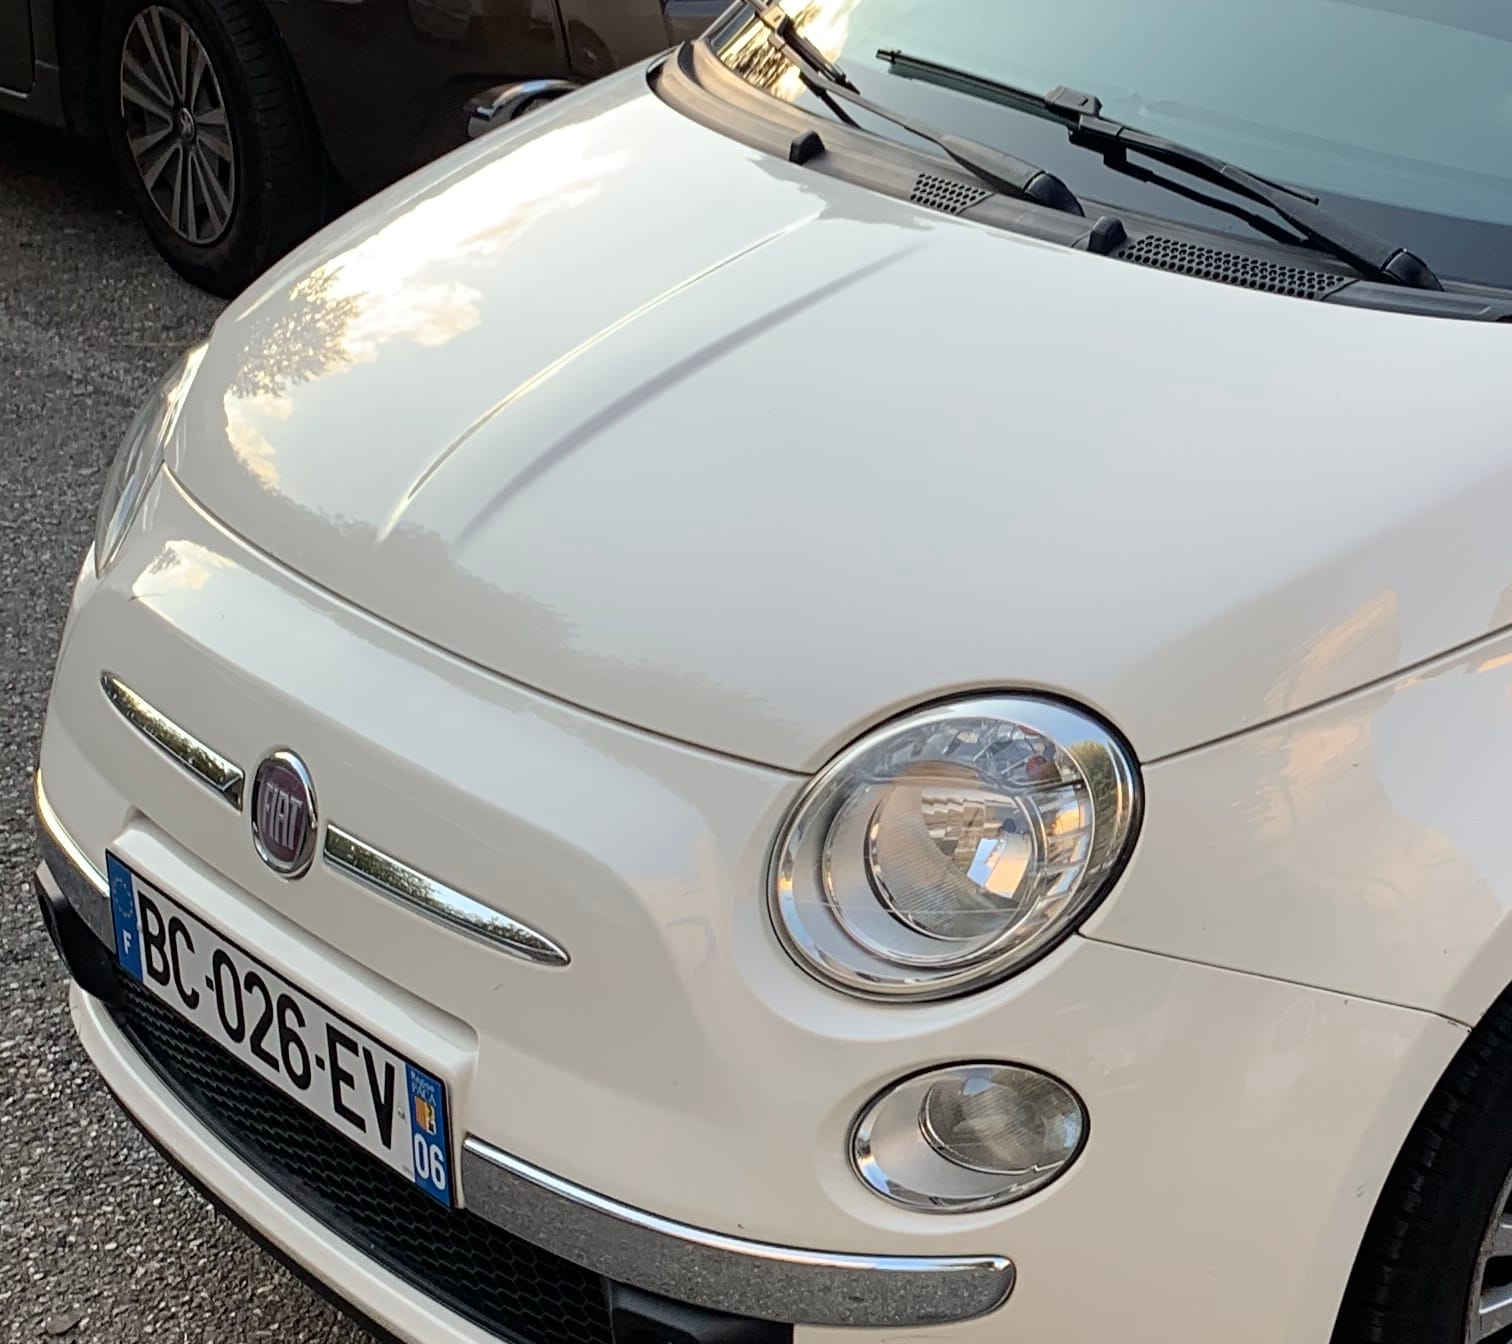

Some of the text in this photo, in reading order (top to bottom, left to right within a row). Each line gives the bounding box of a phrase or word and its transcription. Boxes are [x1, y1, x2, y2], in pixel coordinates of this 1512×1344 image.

[263, 781, 303, 850] FIAT
[122, 928, 132, 955] F
[137, 889, 395, 1150] BC-026-EV
[414, 1132, 446, 1190] 06
